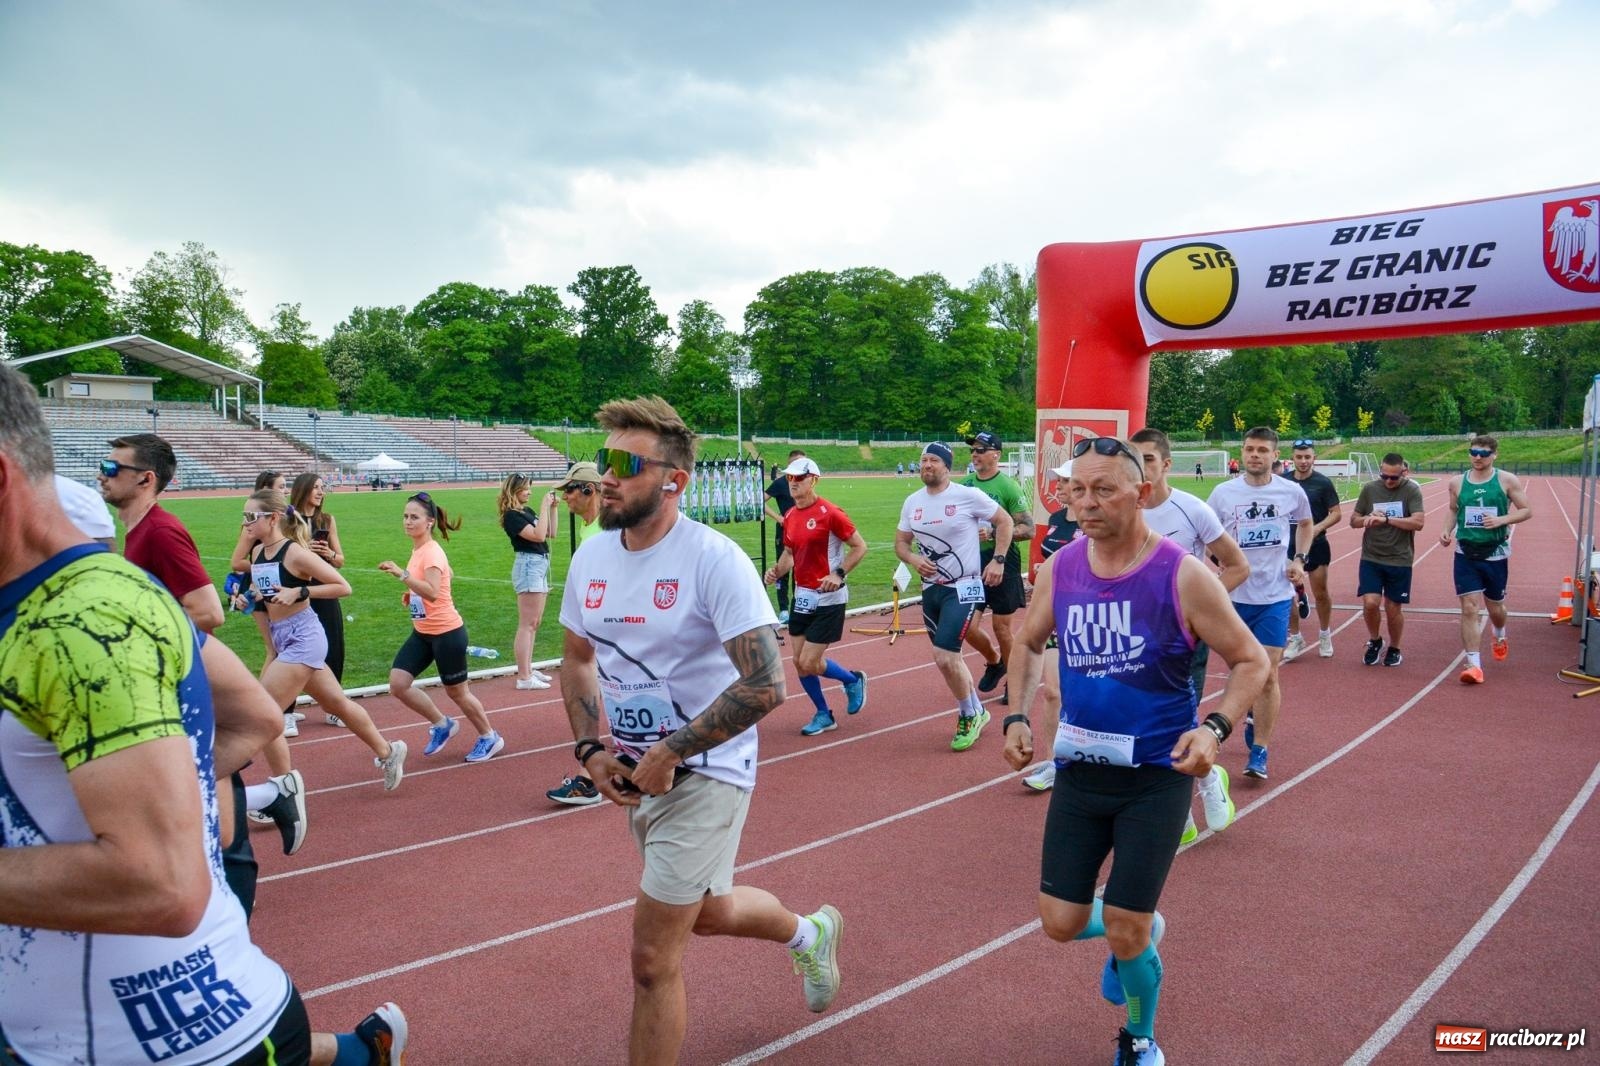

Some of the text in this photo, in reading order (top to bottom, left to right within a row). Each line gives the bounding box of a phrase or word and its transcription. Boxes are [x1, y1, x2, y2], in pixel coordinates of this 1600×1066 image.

[1329, 217, 1425, 246] BIEG
[1187, 250, 1236, 270] SIR
[1265, 241, 1497, 289] BEZ GRANIC
[1285, 283, 1477, 322] RACIBÓRZ
[1247, 529, 1272, 541] 247
[257, 576, 271, 588] 176
[966, 586, 981, 597] 257
[1066, 600, 1131, 656] RUN
[632, 681, 661, 691] GRANIC
[614, 706, 654, 730] 250
[1086, 731, 1099, 739] BEZ
[1099, 734, 1127, 743] GRANIC
[109, 944, 214, 998] SMMASH
[118, 961, 235, 1043] OCR
[141, 988, 252, 1063] LEGION
